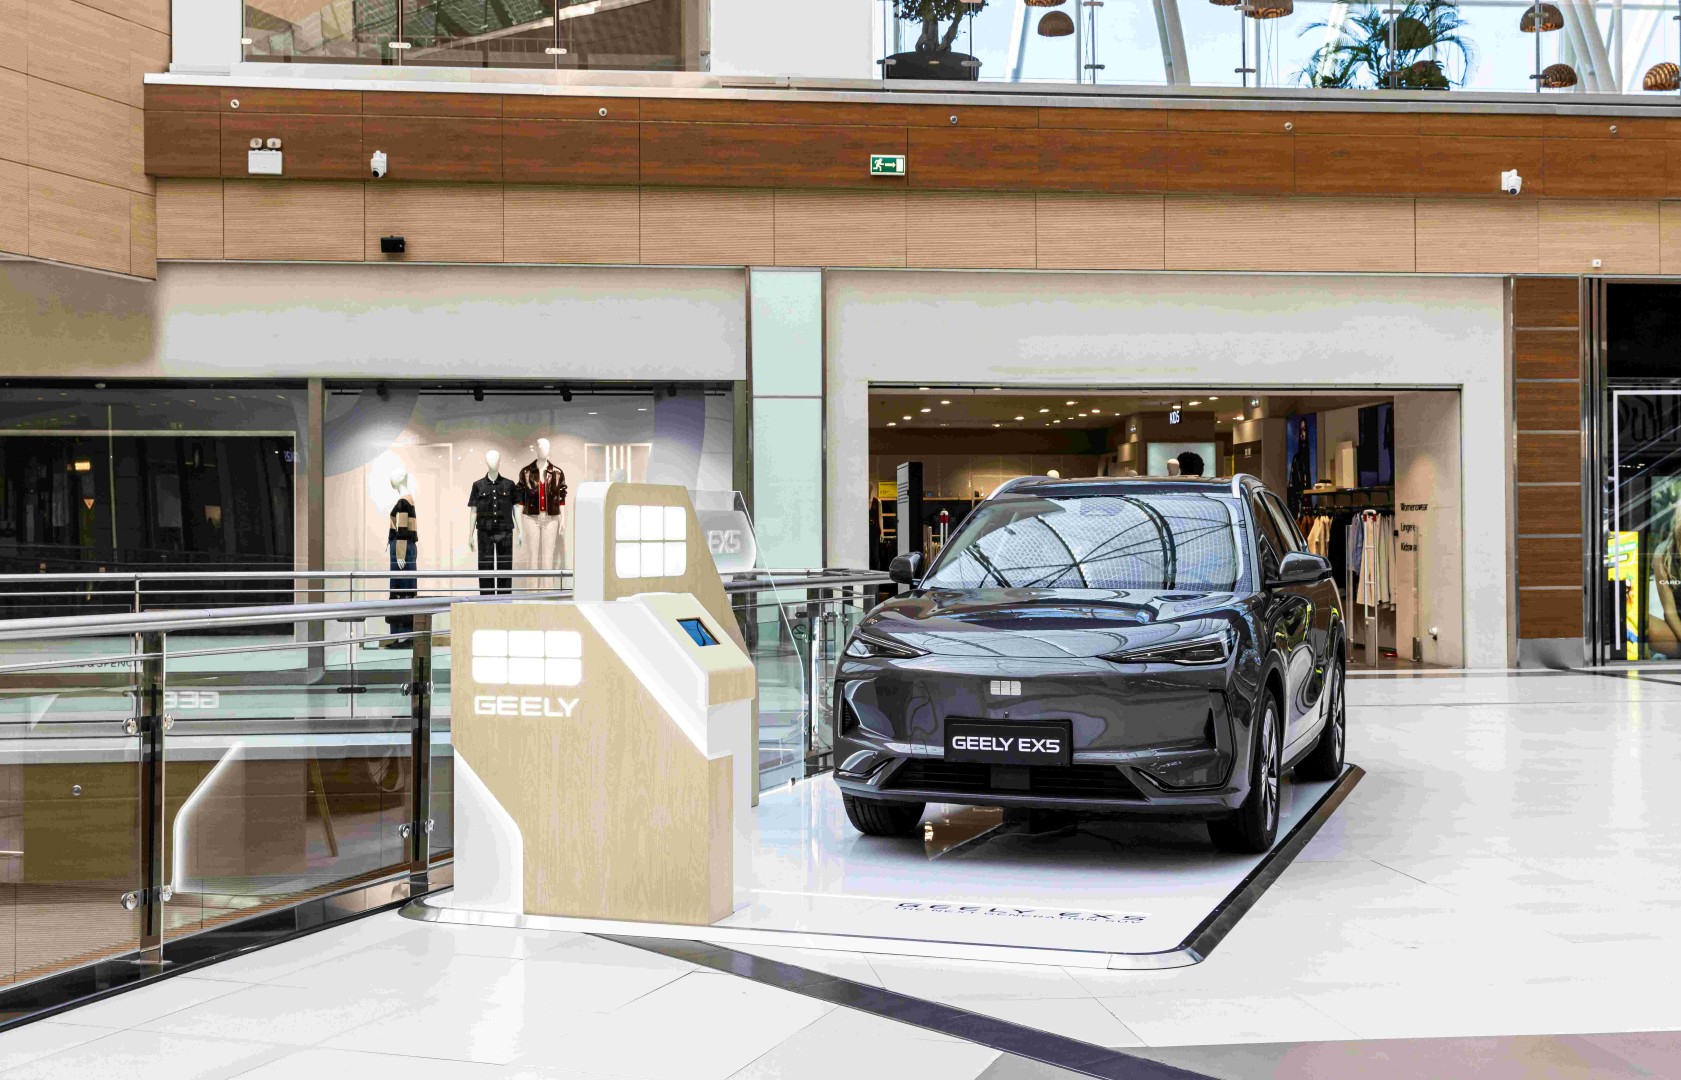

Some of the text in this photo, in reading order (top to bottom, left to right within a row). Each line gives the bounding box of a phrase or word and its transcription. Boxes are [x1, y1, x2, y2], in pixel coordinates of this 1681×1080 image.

[707, 530, 741, 554] EX5
[474, 695, 580, 717] GEELY
[952, 735, 1060, 753] GEELY EX5
[898, 902, 1147, 921] GEELY EX5
